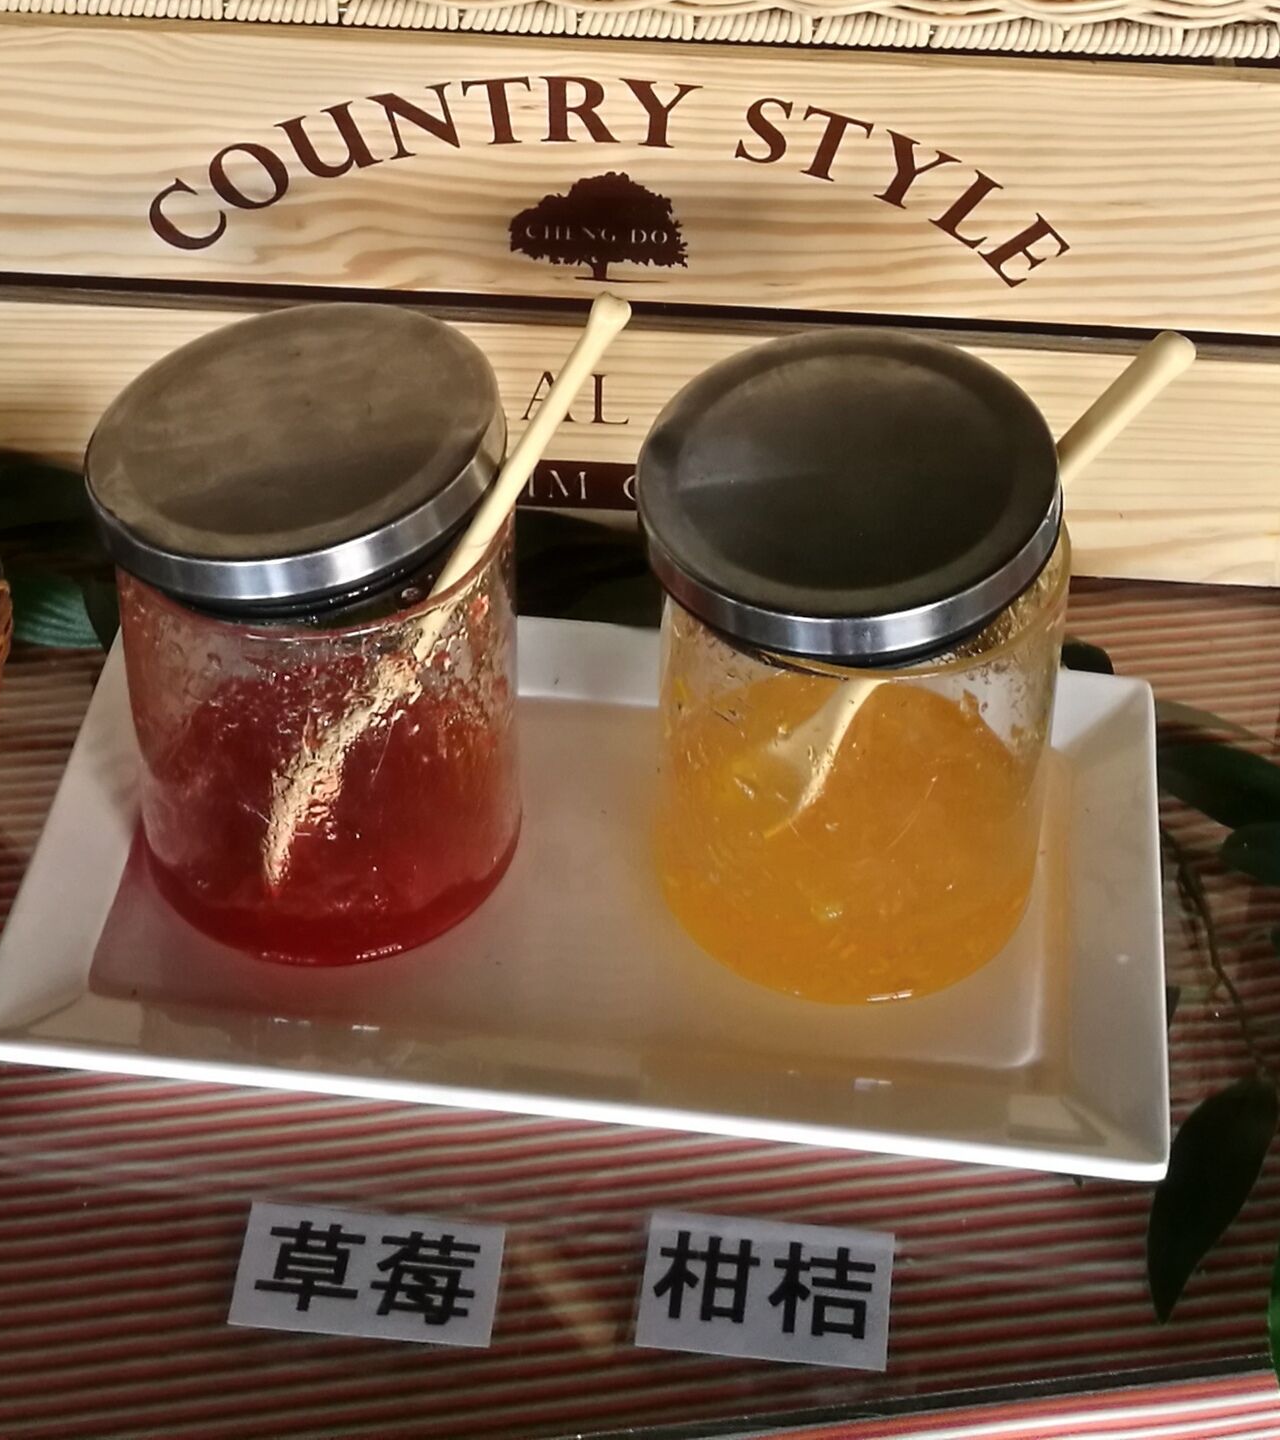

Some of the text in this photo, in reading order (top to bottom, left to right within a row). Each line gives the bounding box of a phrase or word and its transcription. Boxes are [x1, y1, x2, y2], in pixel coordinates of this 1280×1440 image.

[148, 76, 1070, 288] COUNTRY STYLE
[525, 224, 668, 244] CHENG DO
[253, 1220, 482, 1327] 草莓
[652, 1229, 876, 1340] 柑桔
